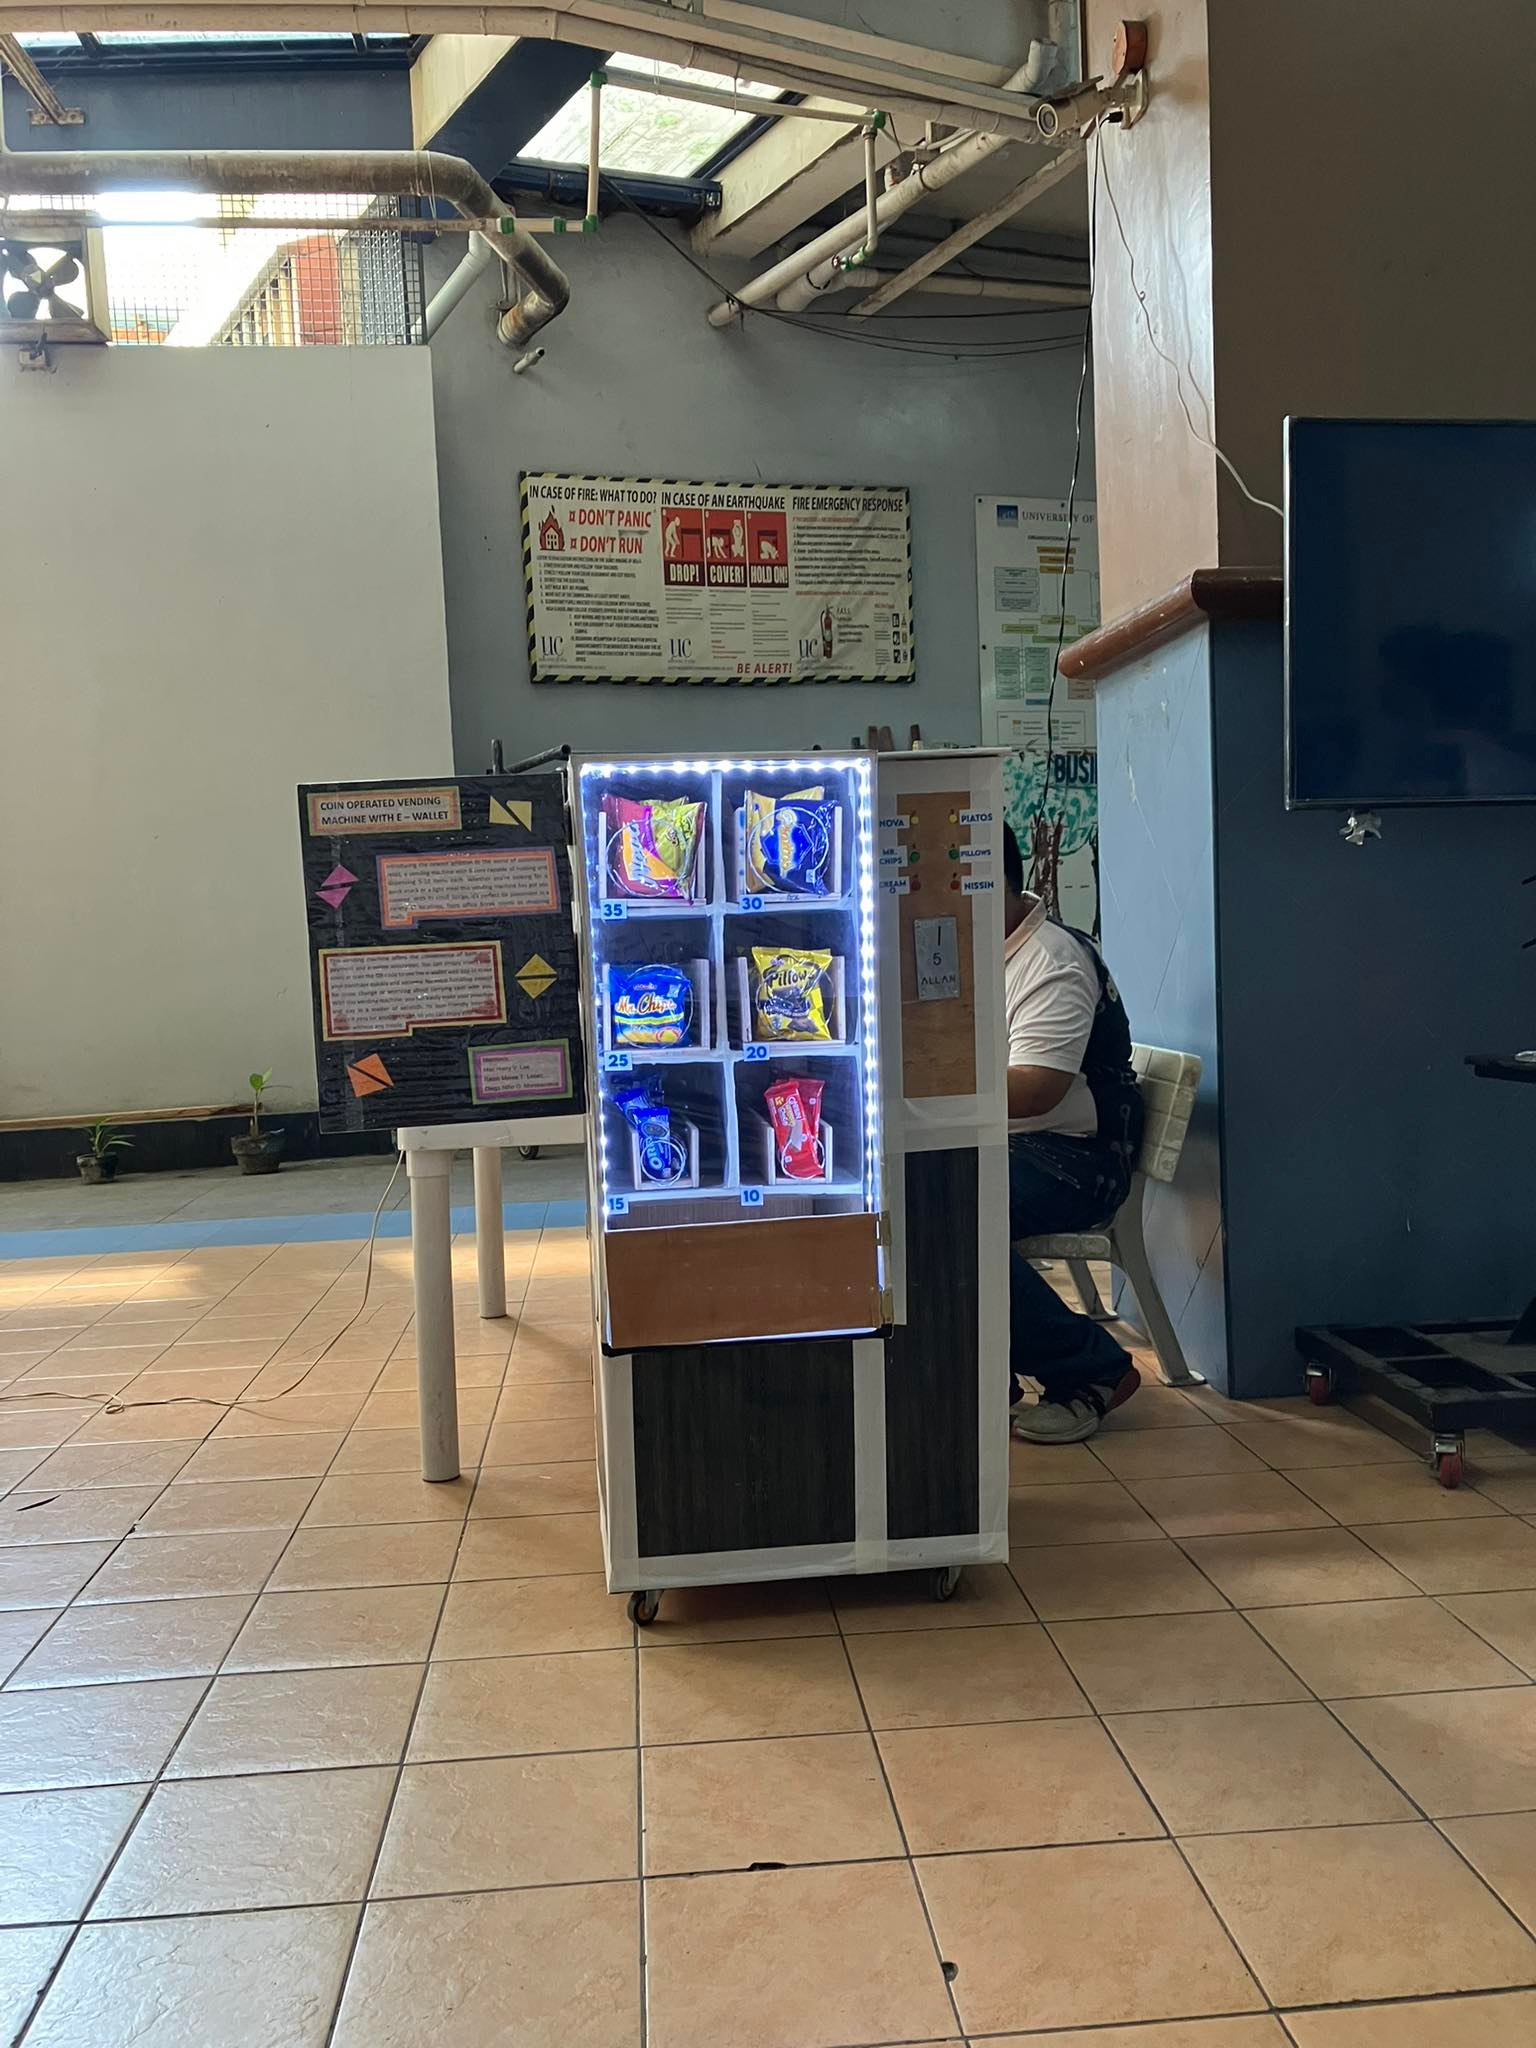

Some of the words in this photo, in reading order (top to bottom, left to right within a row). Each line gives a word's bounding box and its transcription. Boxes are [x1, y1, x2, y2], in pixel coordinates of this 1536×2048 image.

[529, 485, 539, 498] IN
[540, 485, 562, 499] CASE
[564, 487, 576, 500] OF
[577, 487, 598, 501] FIRE:
[600, 488, 625, 502] WHAT
[627, 490, 639, 503] TO
[640, 490, 657, 504] DO?
[661, 491, 671, 505] IN
[673, 492, 696, 506] CASE
[697, 493, 710, 507] OF
[711, 494, 724, 508] AN
[726, 495, 785, 511] EARTHQUAKE
[793, 496, 810, 510] FIRE
[811, 497, 861, 511] EMERGENCY
[862, 498, 903, 512] RESPONSE
[578, 508, 616, 526] DON'T
[617, 510, 652, 528] PANIC
[1022, 511, 1080, 523] UNIVERSIY
[1082, 514, 1095, 524] OF
[580, 535, 617, 553] DON'T
[618, 537, 643, 554] RUN
[669, 563, 699, 582] DROP!
[709, 565, 745, 584] COVER!
[750, 565, 772, 584] HOLD
[773, 566, 788, 584] ON!
[736, 662, 751, 674] BE
[753, 662, 792, 674] ALERT!
[320, 800, 345, 811] COIN
[346, 798, 395, 810] OPERATED
[398, 796, 441, 808] VENDING
[321, 814, 367, 825] MACHINE
[369, 813, 394, 823] WITH
[396, 813, 402, 822] E
[412, 810, 449, 821] WALLET
[879, 819, 905, 828] NOVA
[961, 812, 993, 823] PIATOS
[960, 849, 992, 857] PILLOWS
[964, 881, 994, 890] NISSIN
[603, 903, 623, 917] 35
[742, 897, 763, 910] 30
[932, 952, 942, 966] 5
[921, 975, 956, 985] ALLAN
[615, 994, 637, 1015] Mr.
[746, 1045, 768, 1059] 20
[608, 1054, 629, 1067] 25
[743, 1189, 760, 1202] 10
[608, 1197, 625, 1210] 15
